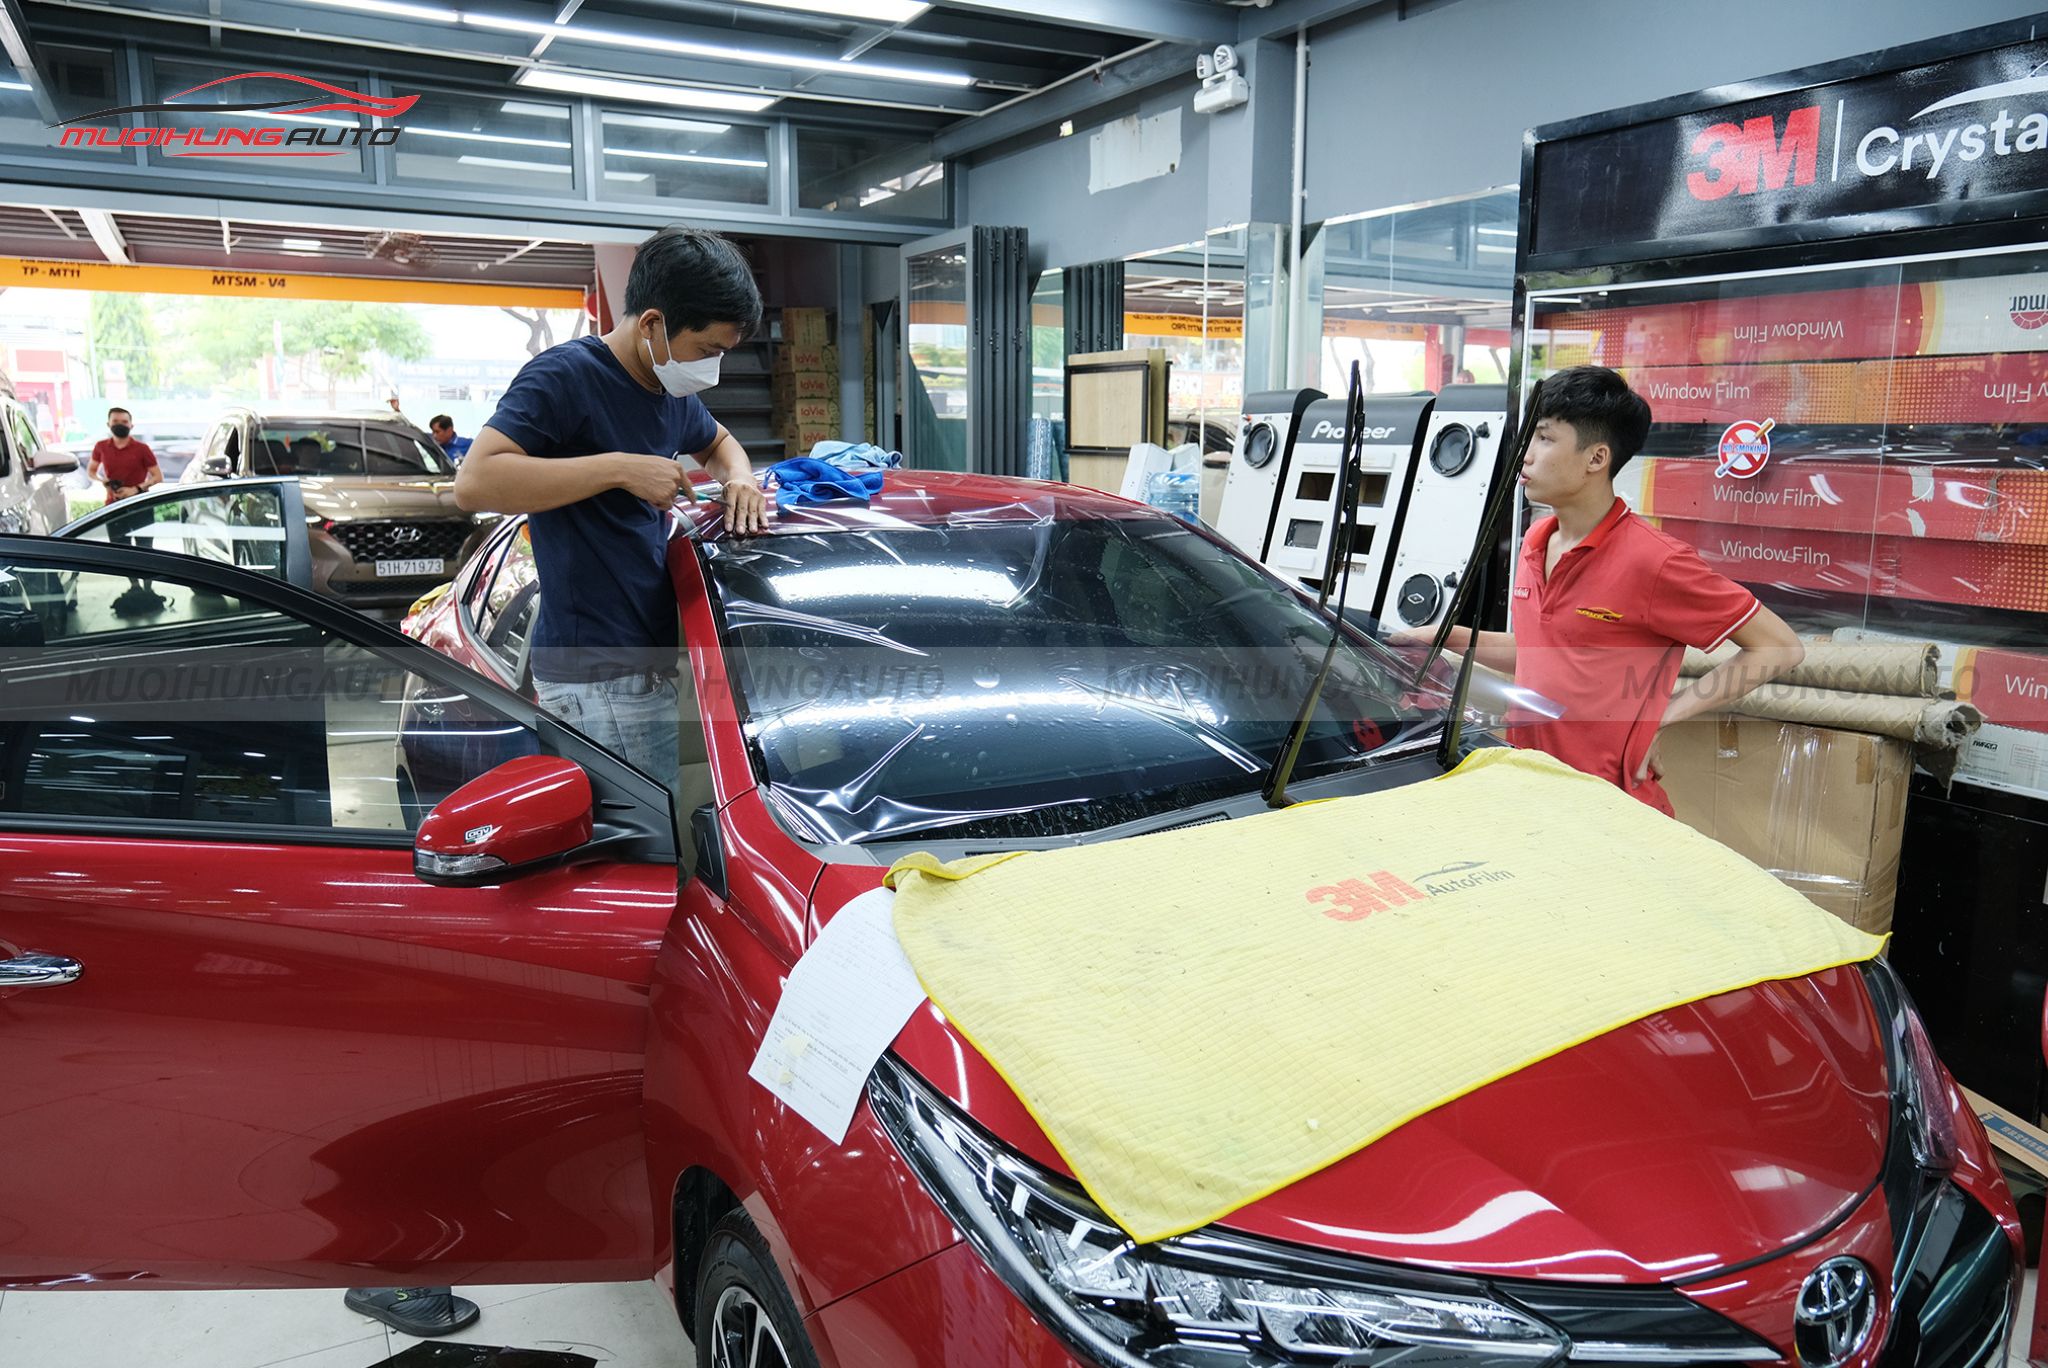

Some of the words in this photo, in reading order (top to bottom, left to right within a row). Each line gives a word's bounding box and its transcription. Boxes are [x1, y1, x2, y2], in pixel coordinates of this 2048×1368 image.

[1687, 106, 1821, 201] 3M
[1855, 109, 2048, 180] Crysta
[22, 266, 39, 275] TP
[49, 268, 80, 278] MT11
[212, 275, 257, 287] MTSM
[268, 277, 286, 288] V4
[1734, 325, 1768, 343] Film
[1771, 320, 1844, 341] Window
[1649, 381, 1712, 399] Window
[1715, 381, 1750, 399] Film
[1984, 382, 2032, 404] Film
[1310, 420, 1396, 440] Pioeer
[1723, 443, 1733, 453] NO
[1736, 443, 1767, 455] SMOKING
[1713, 484, 1779, 505] Window
[1783, 487, 1821, 508] Film
[1720, 539, 1789, 561] Window
[1792, 546, 1830, 566] Film
[2005, 673, 2048, 700] Win
[1305, 870, 1426, 921] 3M
[1425, 869, 1515, 896] AutoFilm
